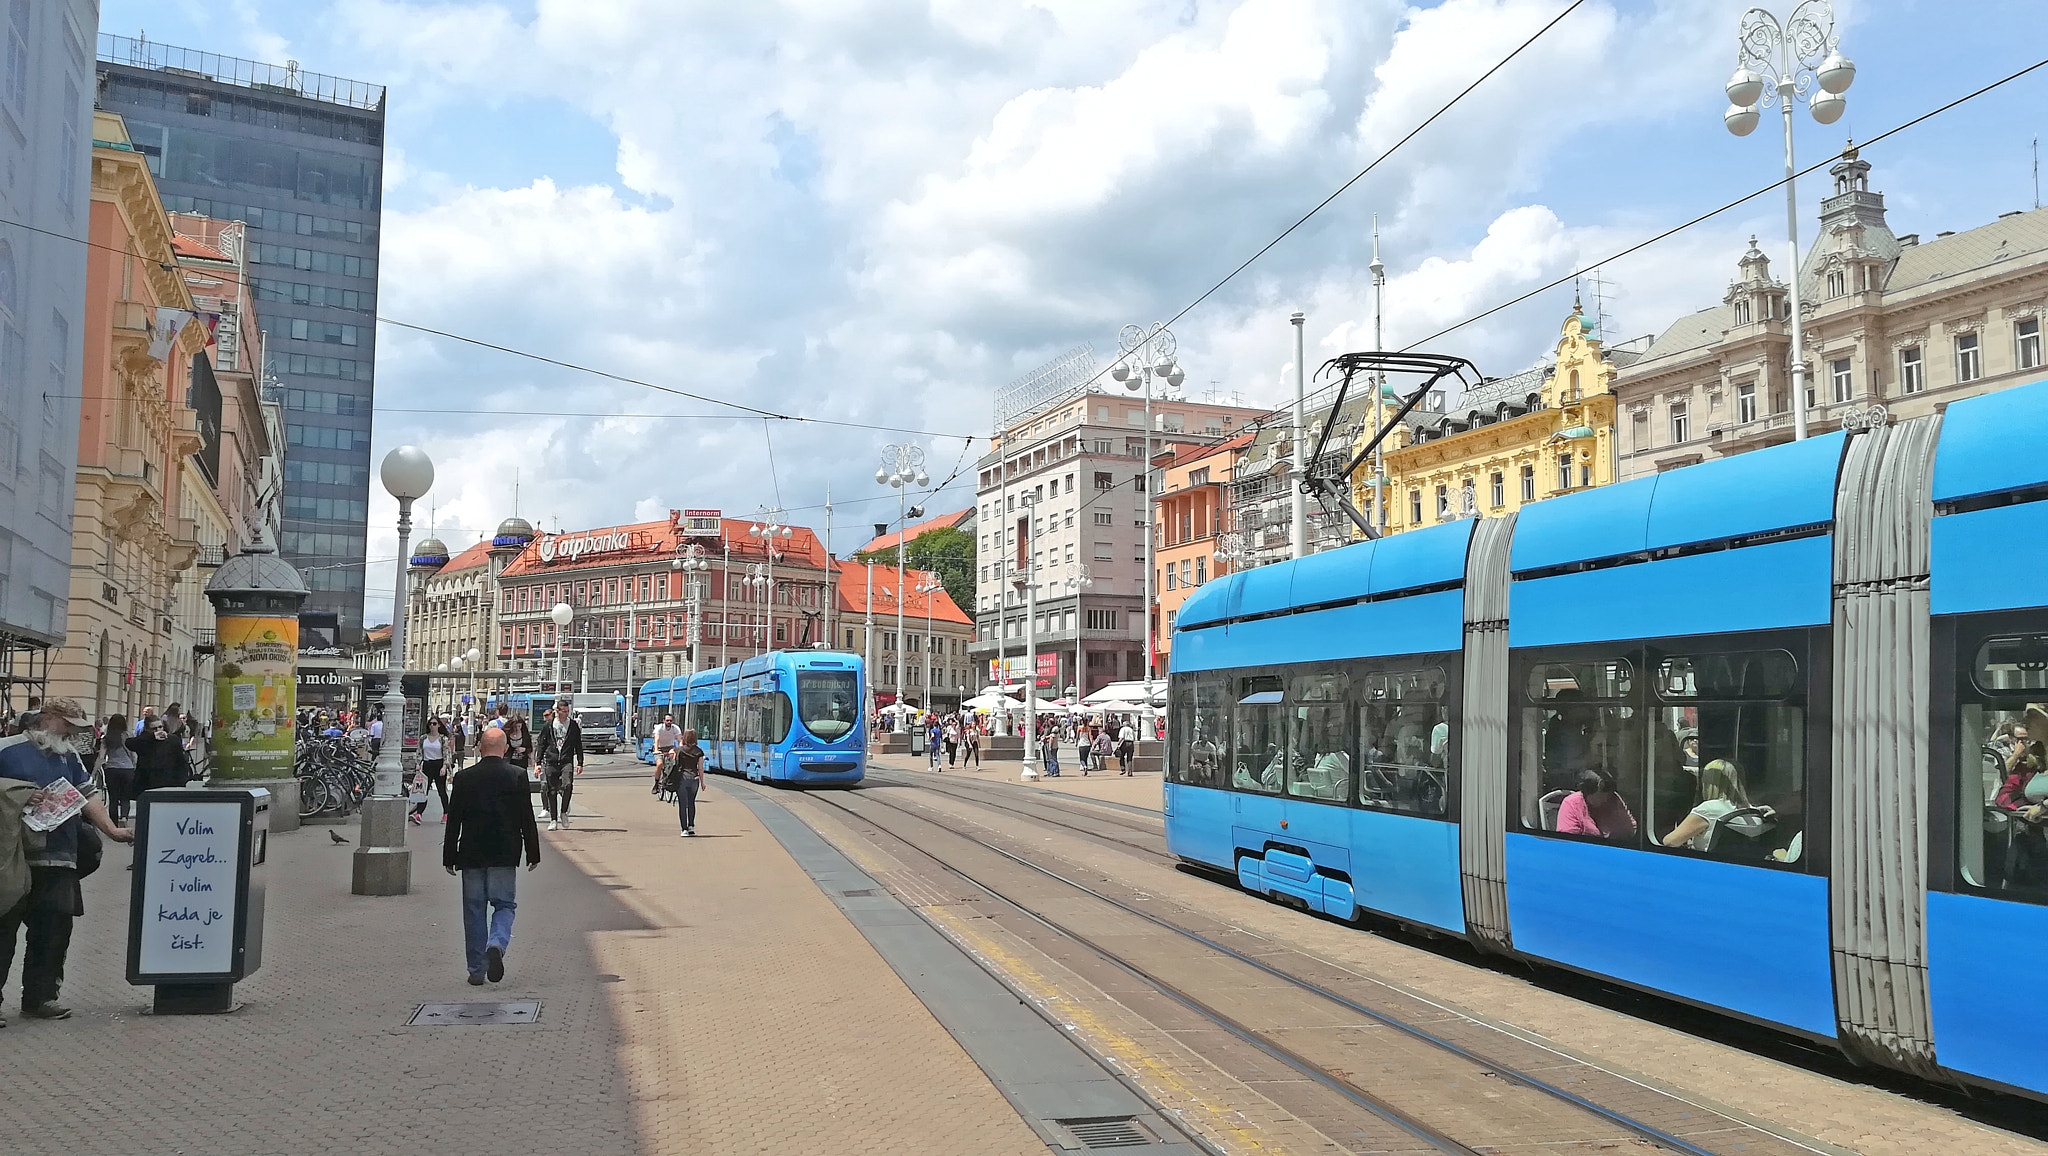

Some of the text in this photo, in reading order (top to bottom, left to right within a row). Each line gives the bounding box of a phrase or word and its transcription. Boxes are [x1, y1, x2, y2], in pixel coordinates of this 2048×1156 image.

[176, 817, 214, 836] Volim
[158, 847, 227, 870] Zagreb...
[170, 876, 213, 892] i volim
[158, 904, 223, 926] kada je
[171, 934, 205, 950] čist.
